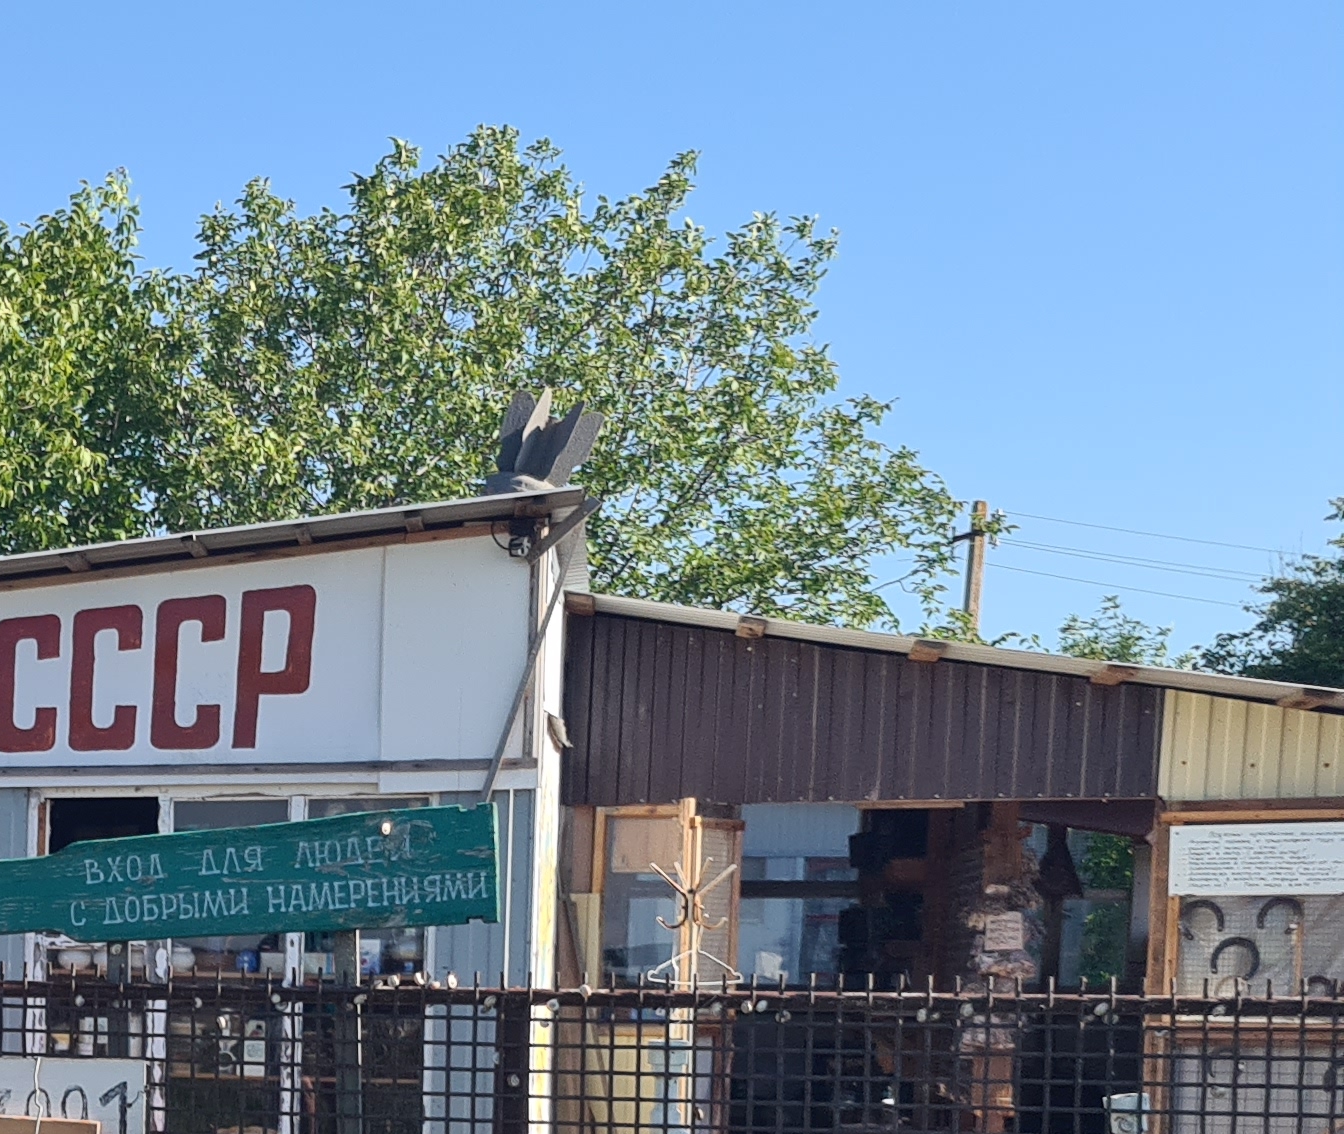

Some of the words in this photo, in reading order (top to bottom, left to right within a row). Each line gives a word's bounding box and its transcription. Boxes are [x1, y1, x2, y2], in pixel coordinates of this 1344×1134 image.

[83, 852, 169, 885] ВХОД
[197, 845, 264, 877] ДЛЯ
[69, 900, 87, 927] С
[102, 886, 250, 925] ДОБРЫМИ
[266, 871, 489, 913] НАМЕРЕНИЯМИ
